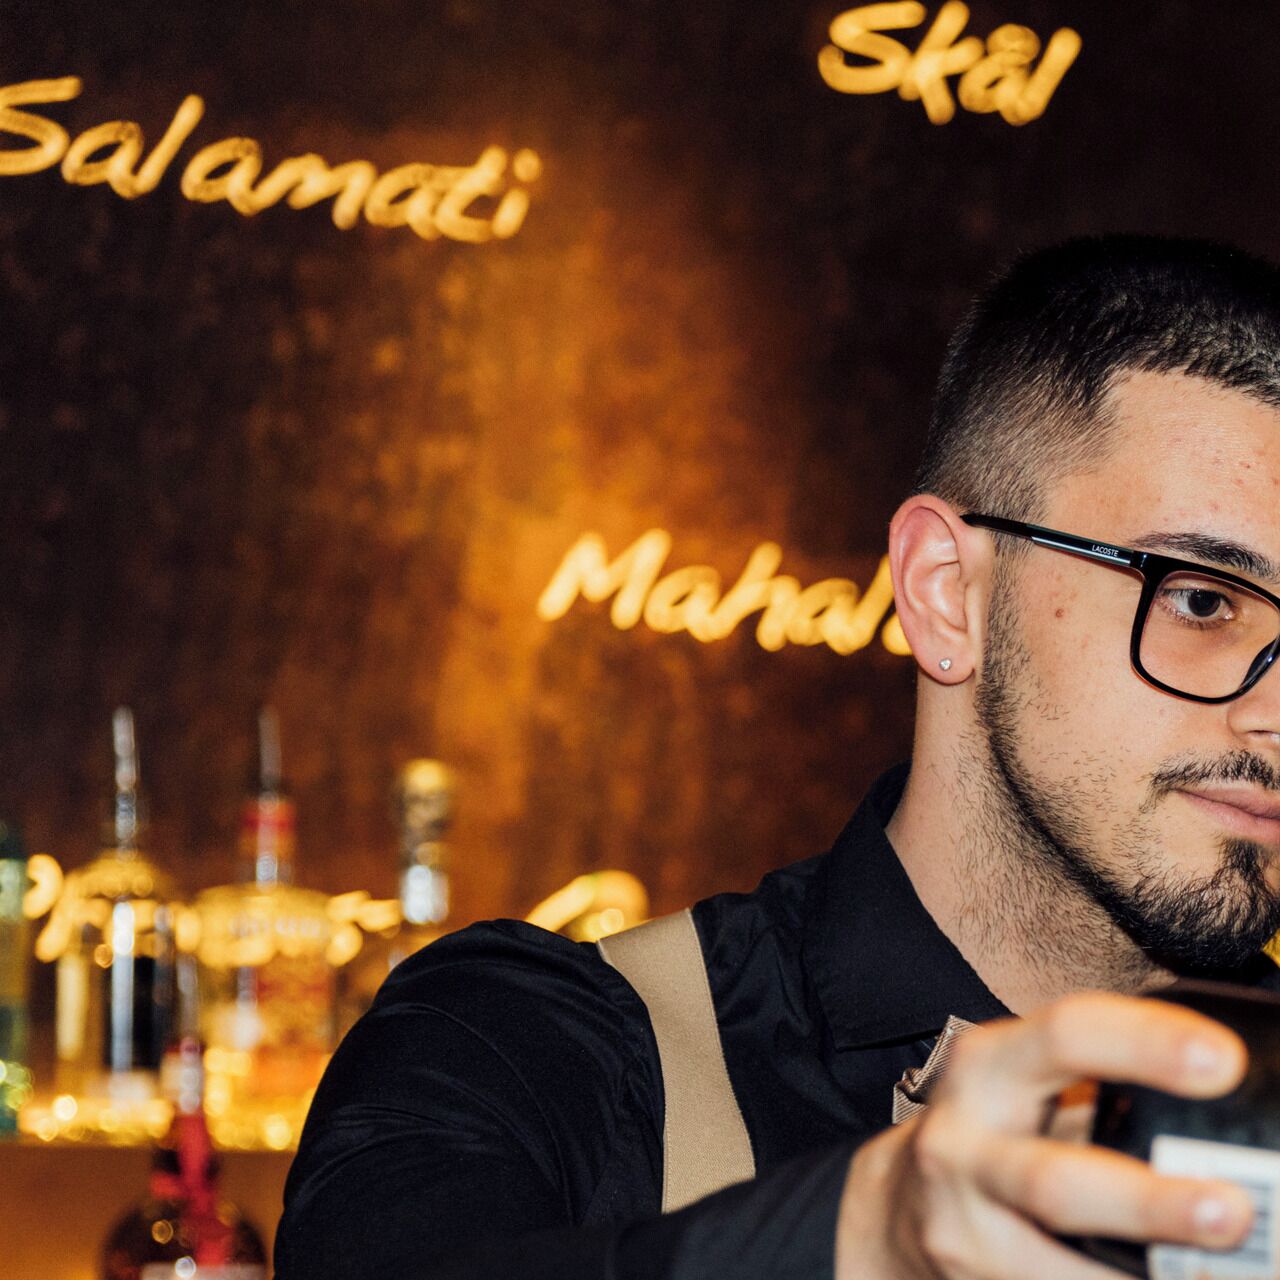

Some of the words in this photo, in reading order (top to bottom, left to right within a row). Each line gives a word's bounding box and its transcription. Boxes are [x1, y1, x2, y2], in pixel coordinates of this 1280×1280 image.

[818, 0, 1081, 124] Skål
[0, 77, 543, 243] Salamati
[1092, 544, 1119, 557] LACOSTE
